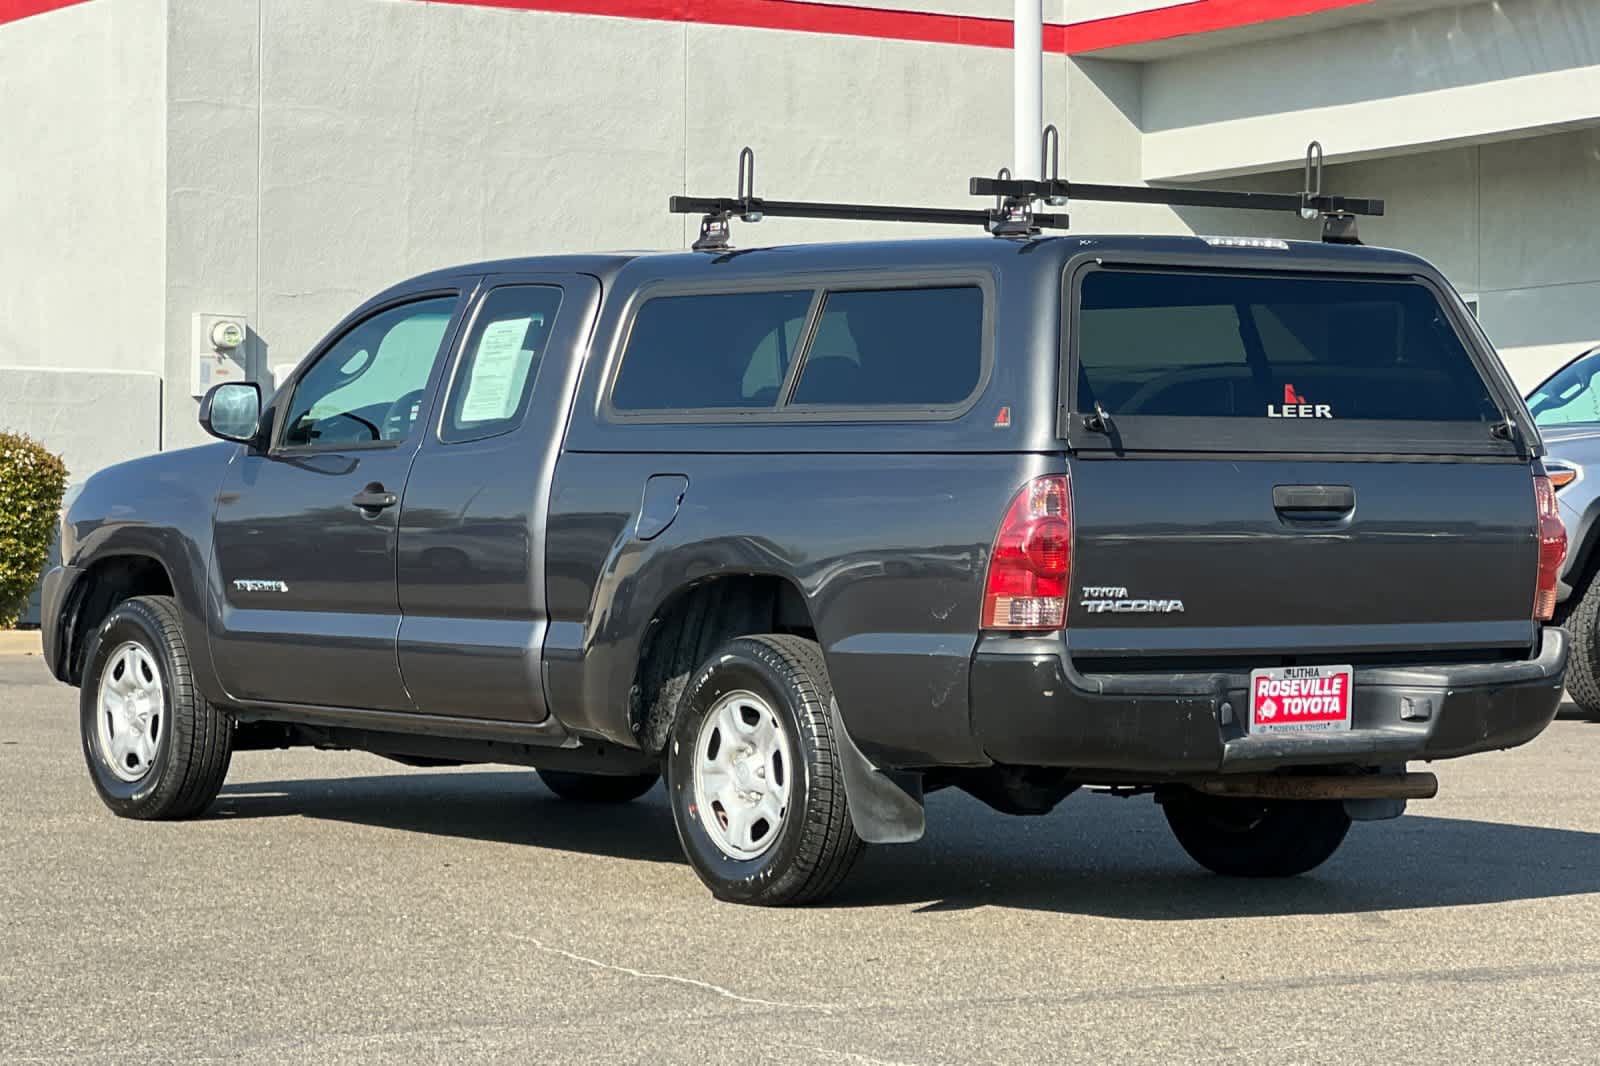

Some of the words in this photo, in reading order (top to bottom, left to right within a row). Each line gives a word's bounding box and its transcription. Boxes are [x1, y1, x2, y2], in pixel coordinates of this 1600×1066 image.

[1267, 404, 1333, 418] LEER
[1082, 586, 1128, 598] TOYOTA
[1080, 599, 1185, 613] TACOMA
[1292, 667, 1320, 678] LITHIA
[1257, 678, 1343, 697] ROSEVILLE
[1282, 696, 1341, 715] TOYOTA
